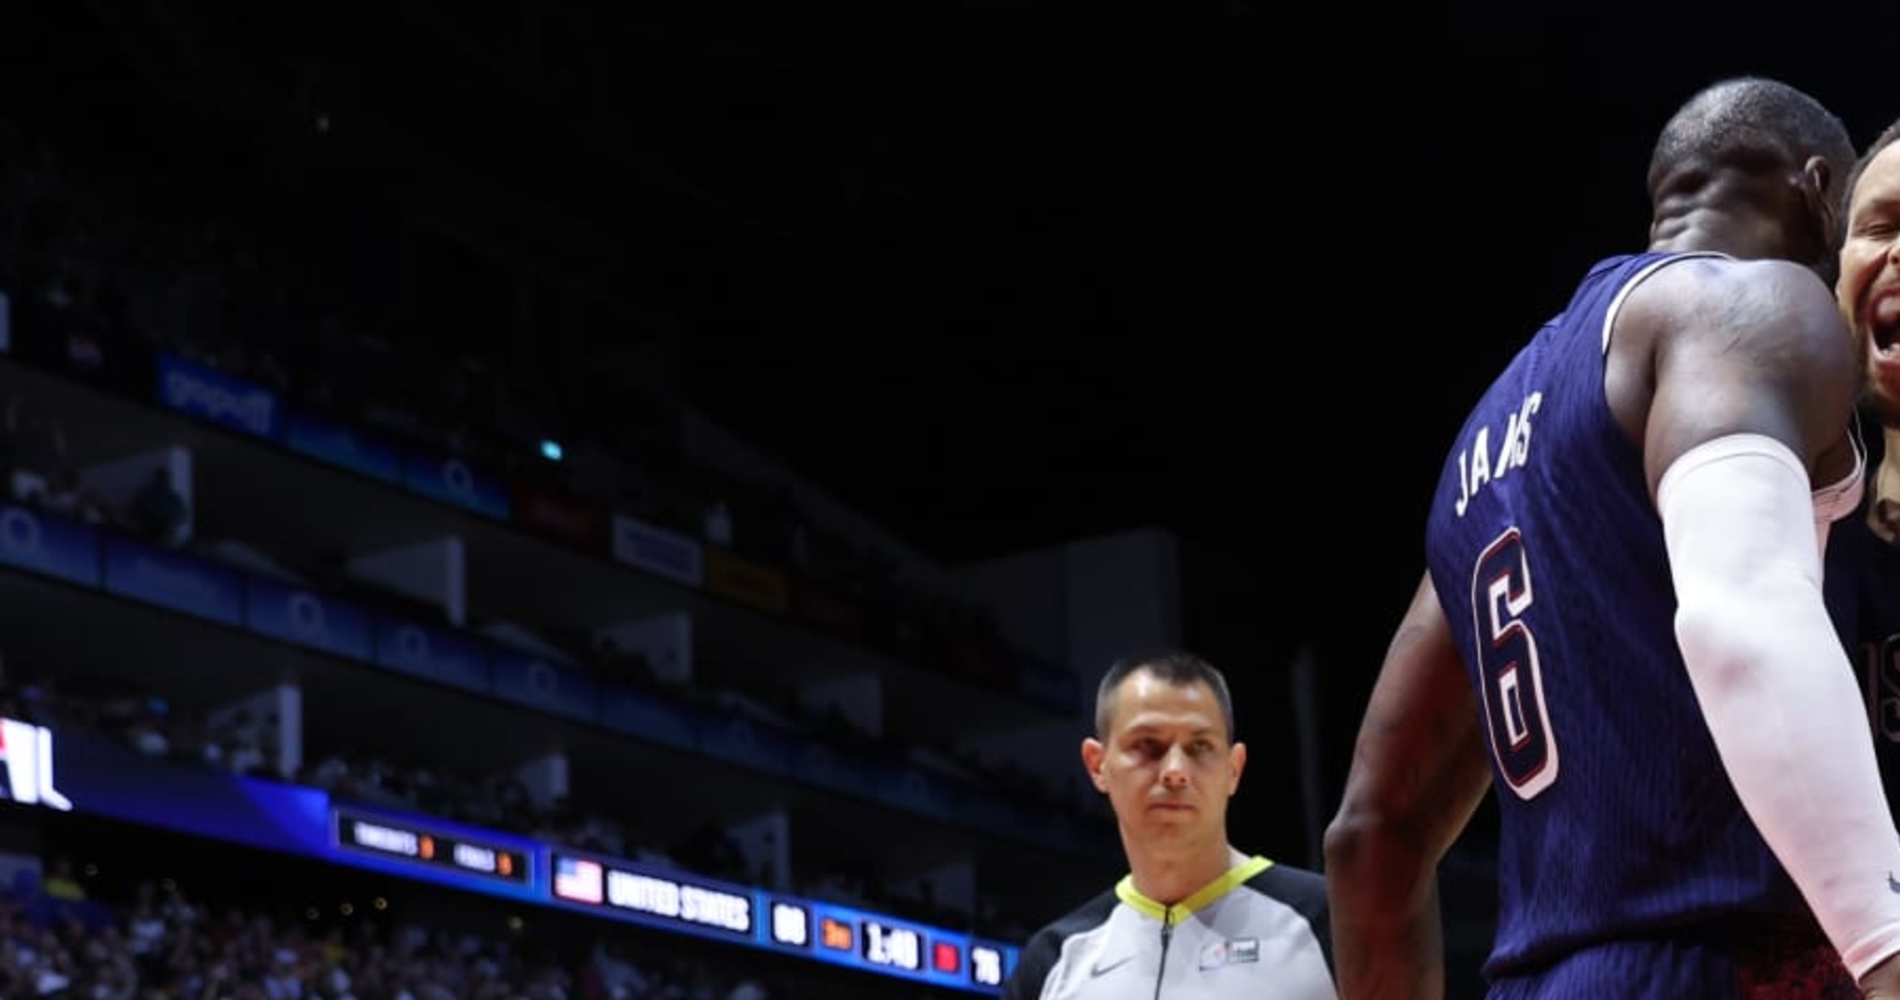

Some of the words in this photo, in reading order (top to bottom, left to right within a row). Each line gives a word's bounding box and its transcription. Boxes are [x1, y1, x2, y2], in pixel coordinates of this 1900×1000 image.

[1455, 391, 1543, 518] JAS
[1470, 526, 1560, 801] 6
[608, 870, 679, 916] UNITED
[680, 885, 749, 931] STATES
